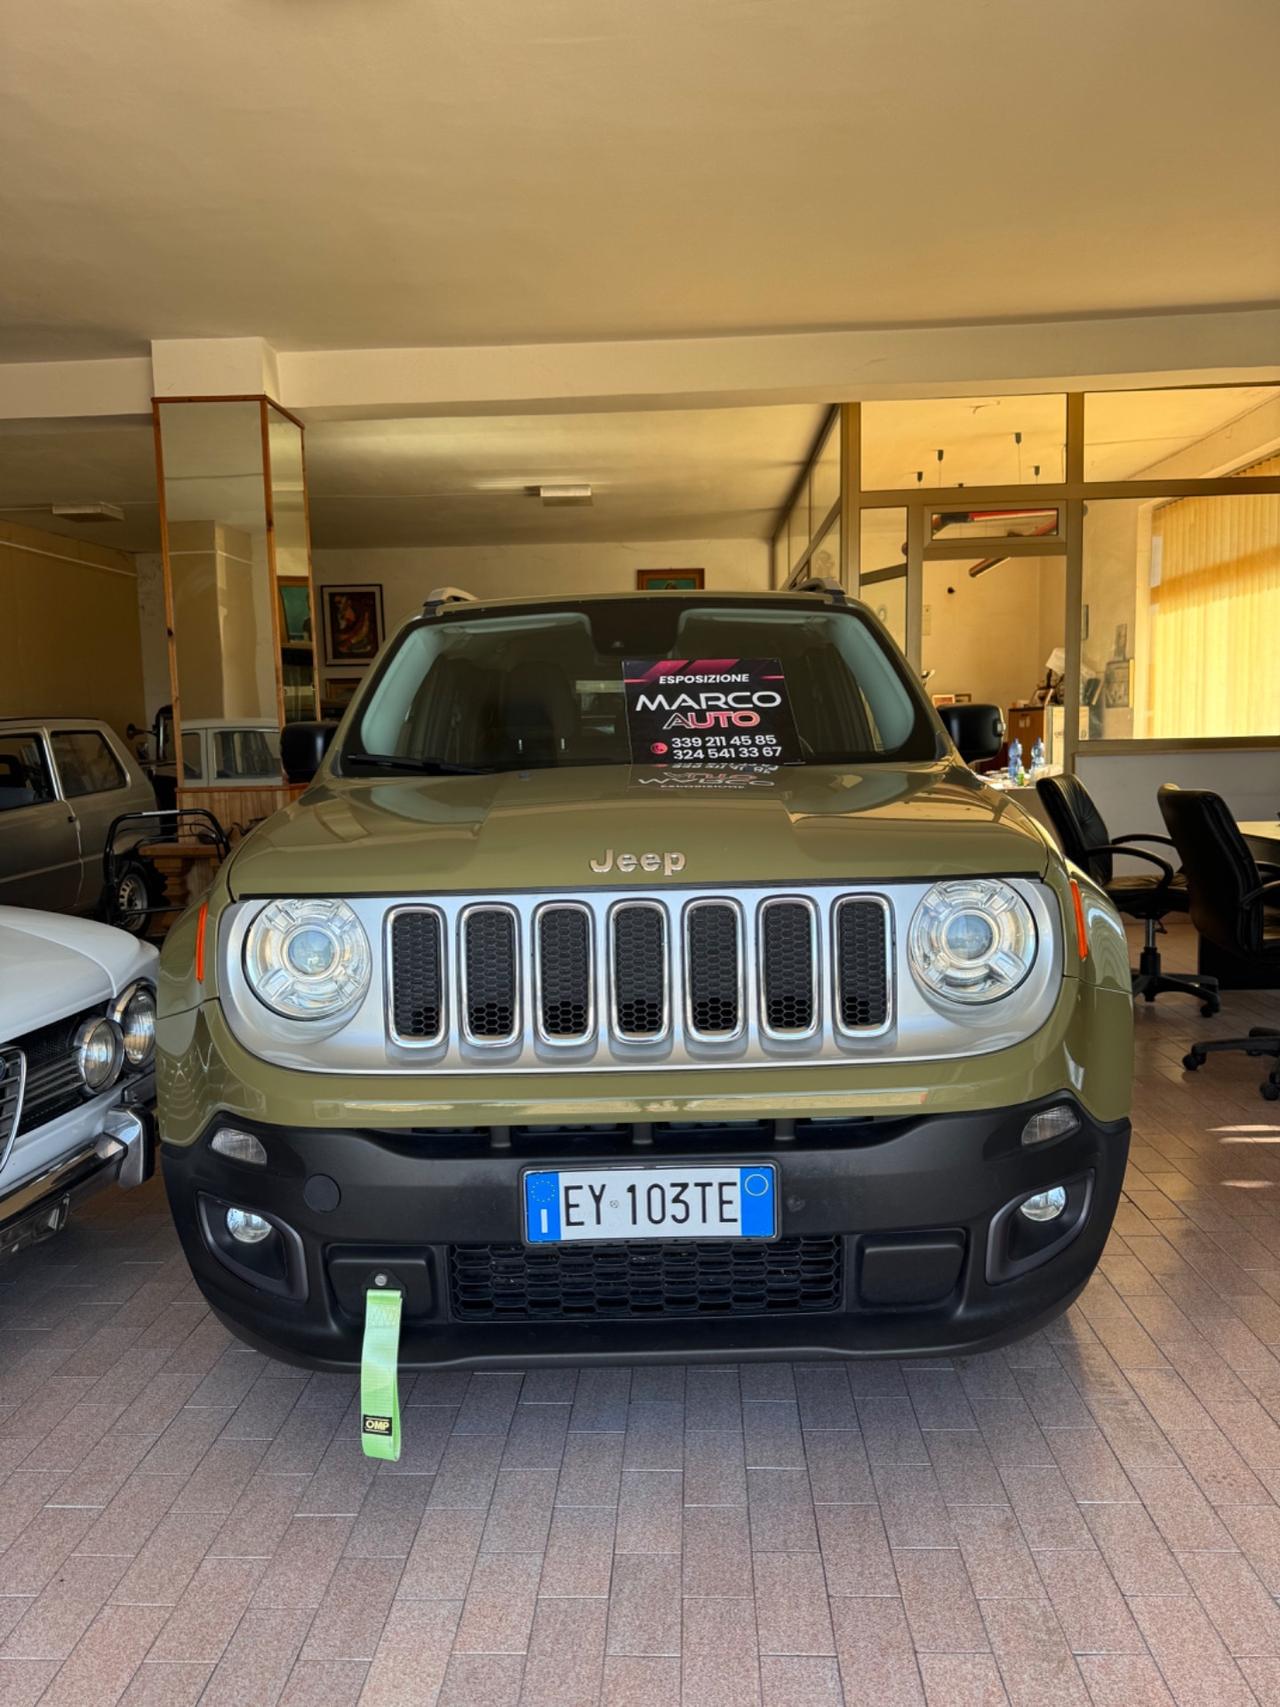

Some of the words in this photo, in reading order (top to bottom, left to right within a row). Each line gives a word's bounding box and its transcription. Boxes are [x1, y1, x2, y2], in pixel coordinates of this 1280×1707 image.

[658, 673, 750, 684] ESPOSIZIONE
[635, 691, 782, 711] MARCO
[662, 710, 761, 730] AUTO
[671, 737, 702, 748] 339
[705, 736, 726, 747] 211
[729, 735, 752, 746] 45
[755, 734, 777, 745] 85
[673, 749, 705, 760] 324
[707, 748, 735, 759] 541
[739, 747, 759, 758] 33
[762, 746, 782, 757] 67
[590, 849, 686, 876] Jeep
[563, 1183, 606, 1227] EY
[365, 1420, 390, 1431] OMP
